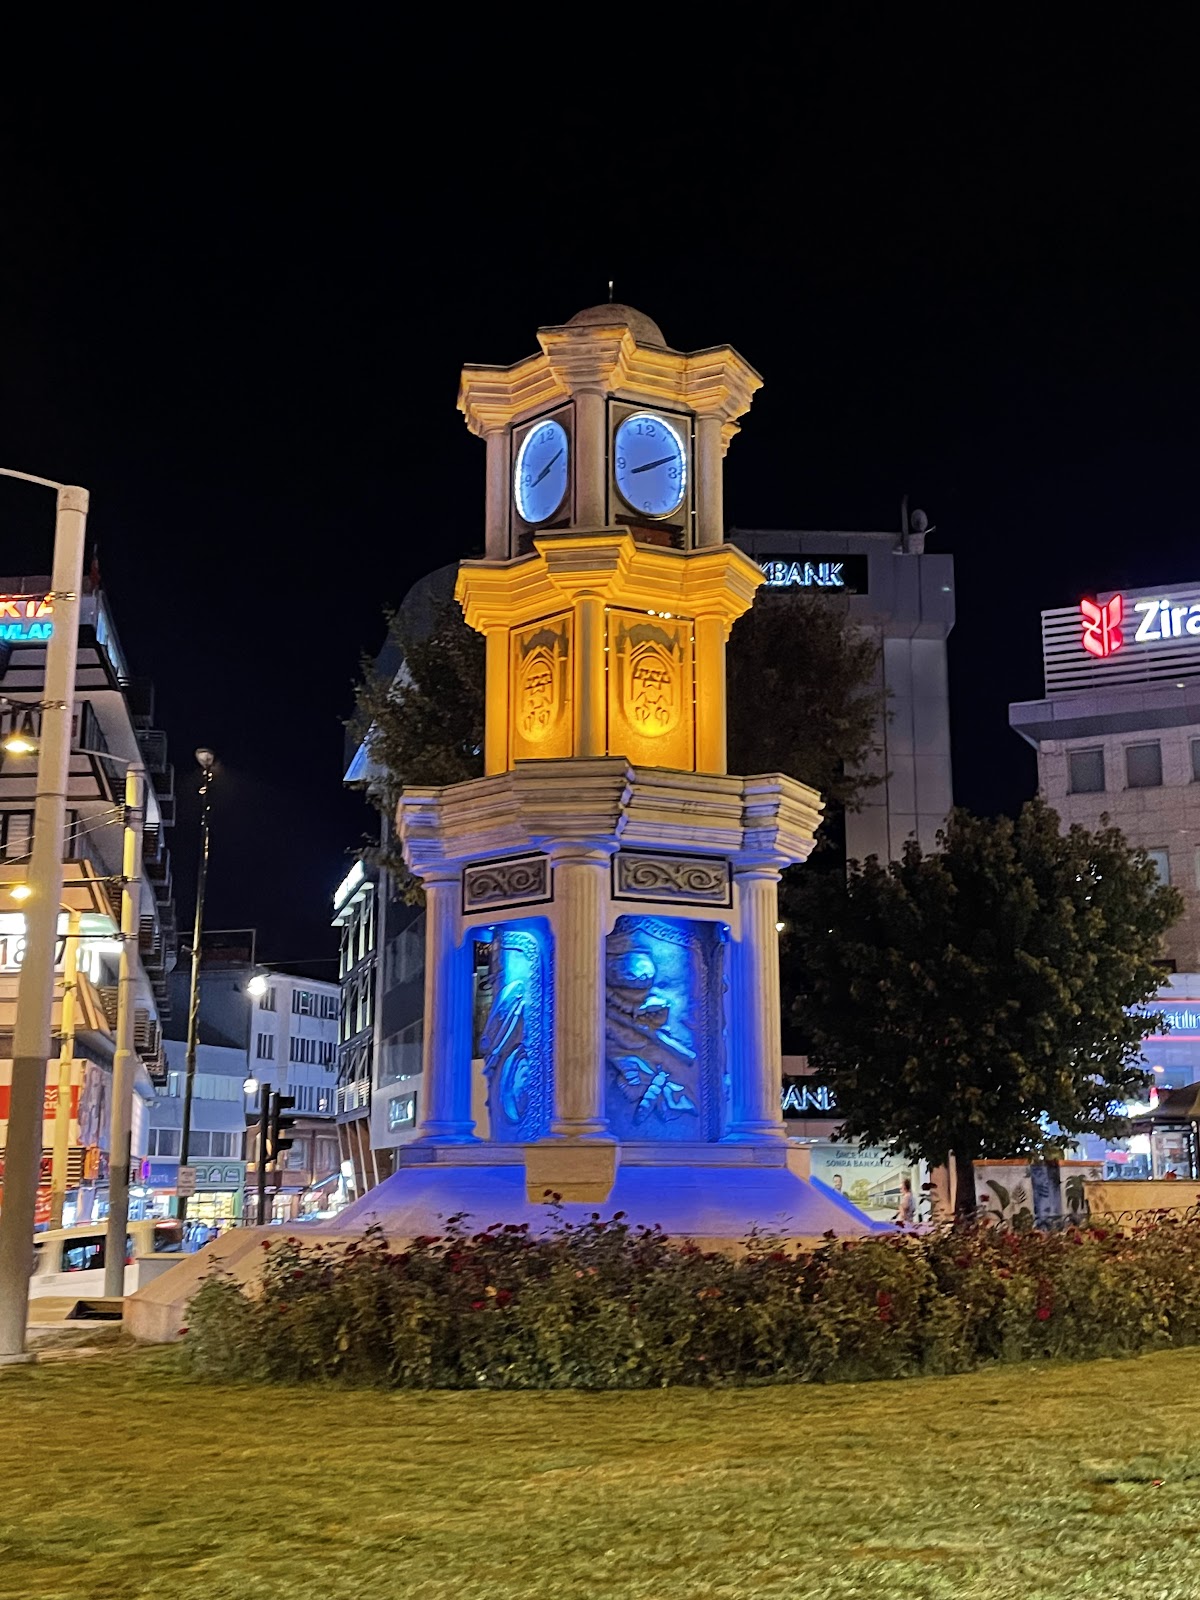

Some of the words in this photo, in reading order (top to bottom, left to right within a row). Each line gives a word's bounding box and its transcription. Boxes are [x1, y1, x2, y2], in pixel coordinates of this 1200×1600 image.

[539, 428, 554, 445] 12
[635, 424, 656, 438] 12
[617, 457, 626, 469] 9
[668, 467, 677, 479] 3
[524, 475, 532, 487] 9
[1134, 600, 1200, 642] Zira
